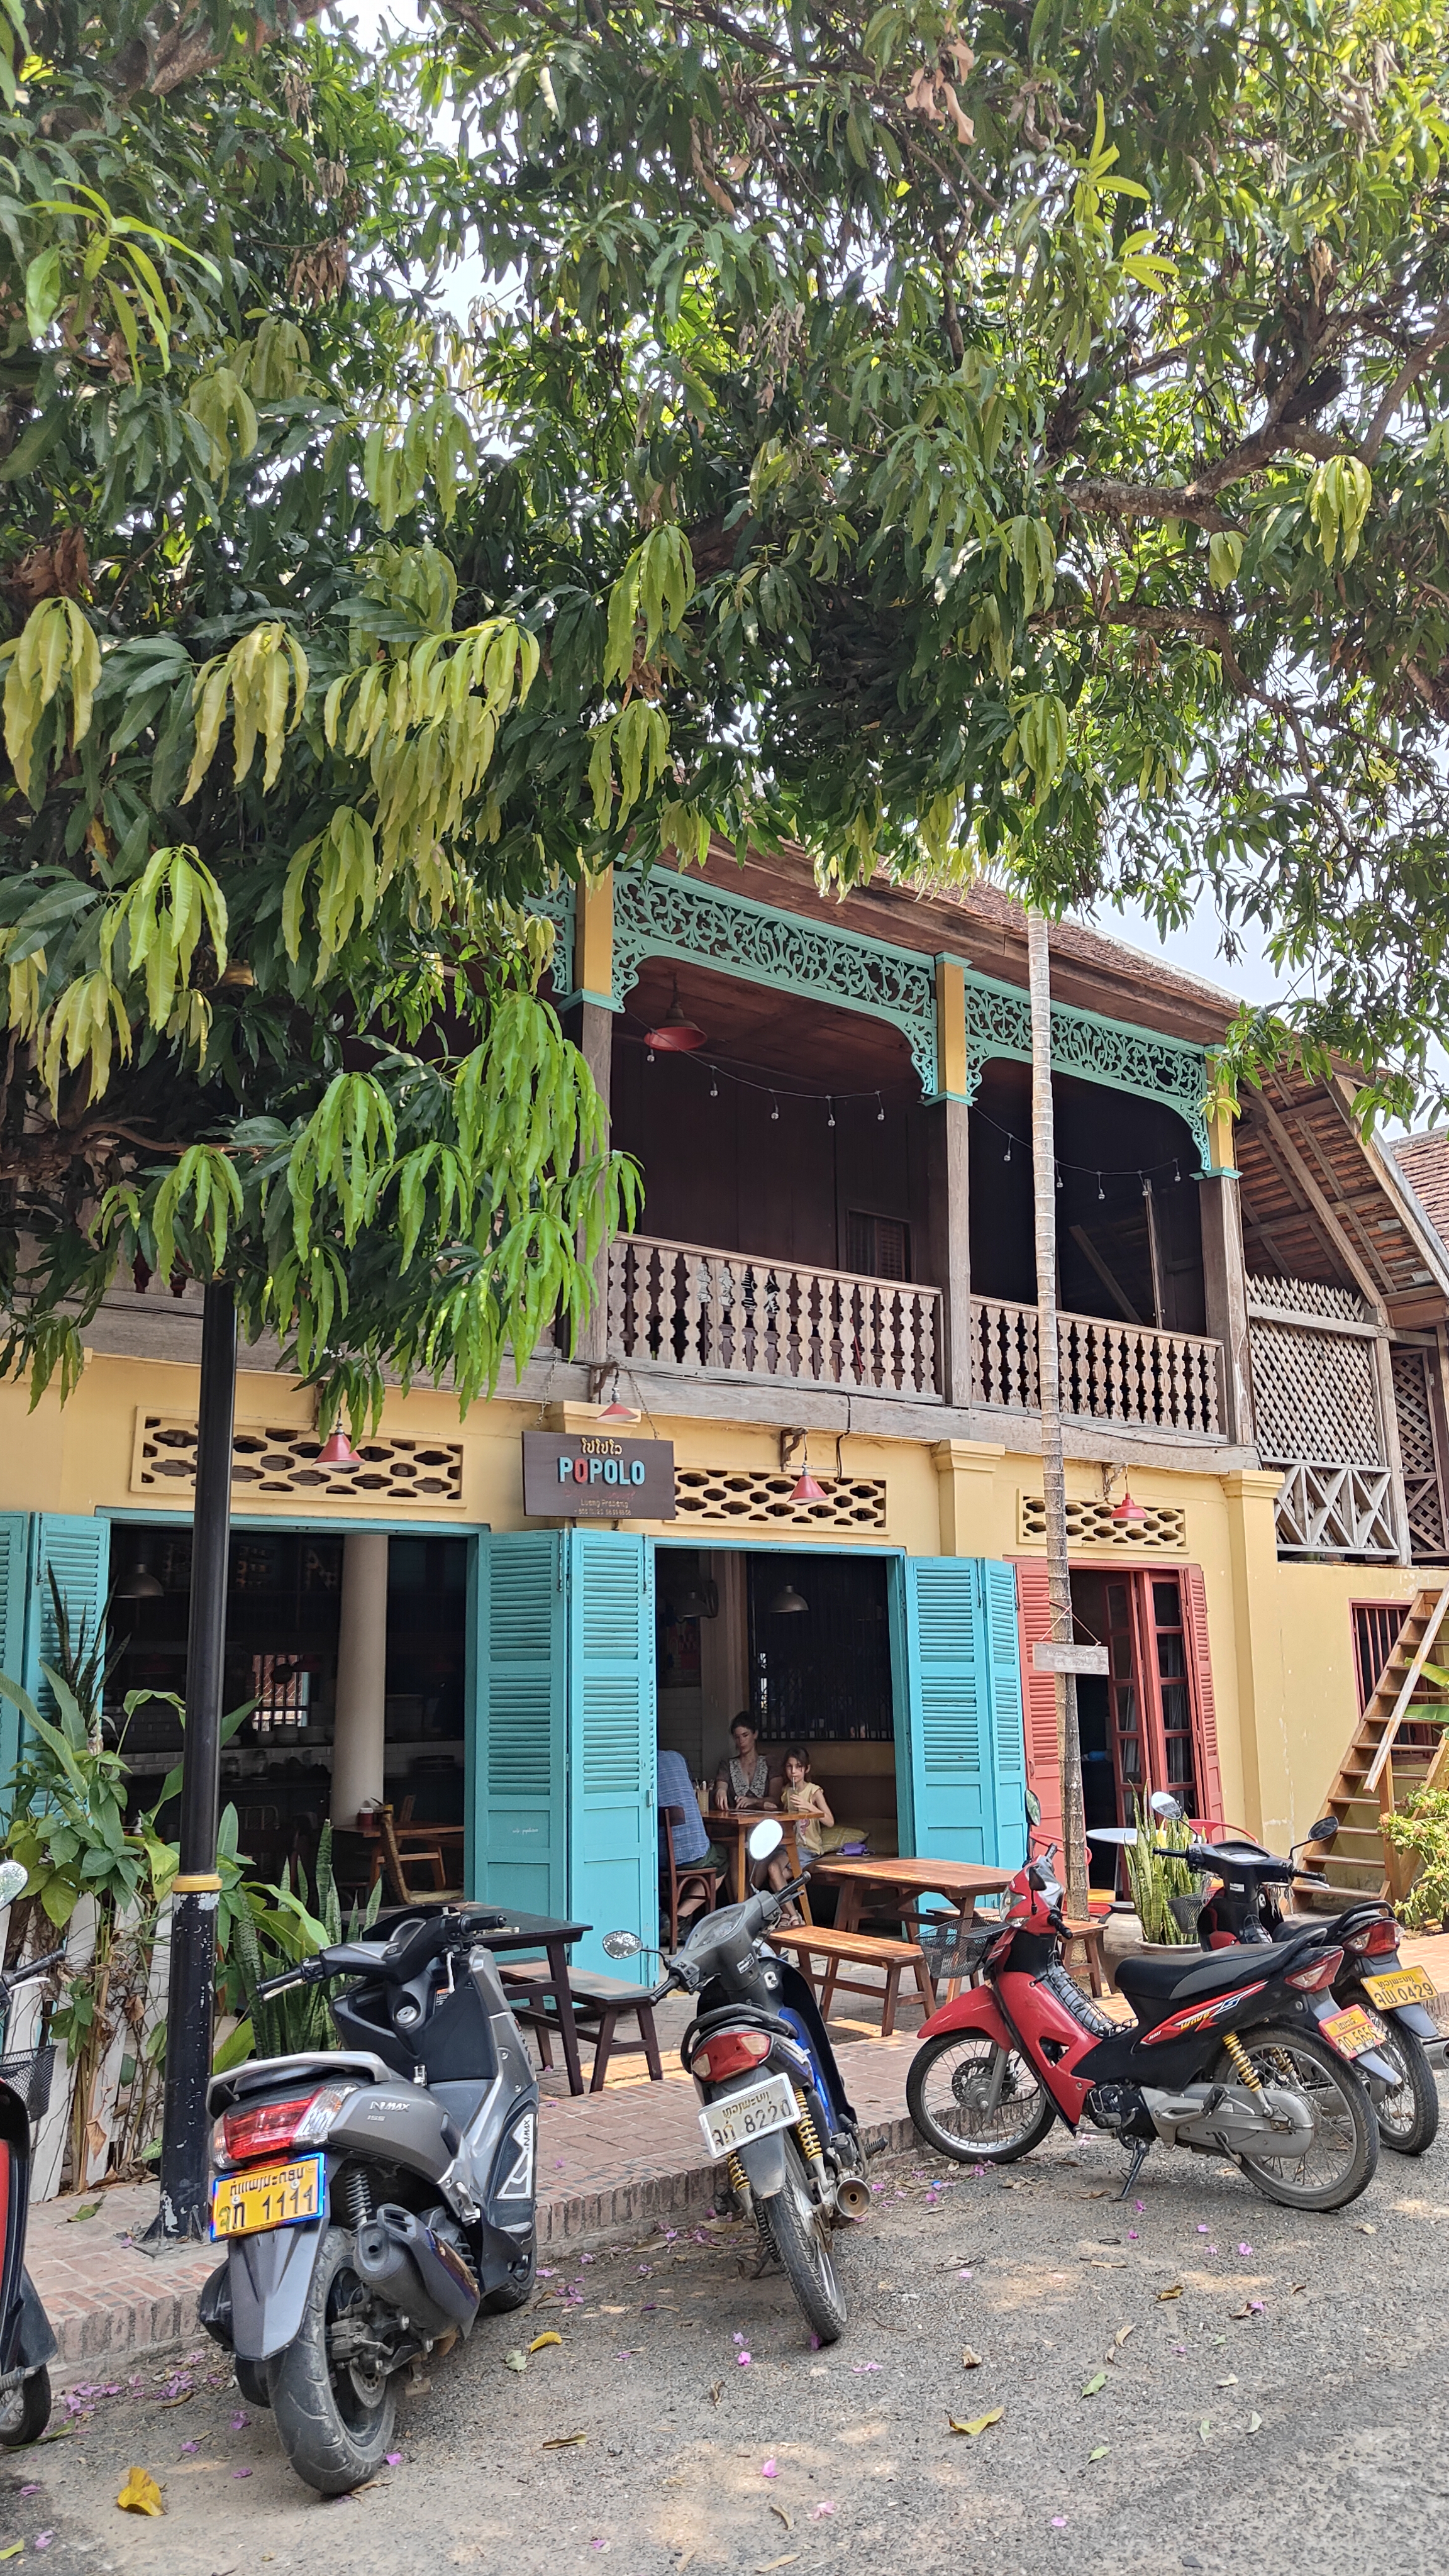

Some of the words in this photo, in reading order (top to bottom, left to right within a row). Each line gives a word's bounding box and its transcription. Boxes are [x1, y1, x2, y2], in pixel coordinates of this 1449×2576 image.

[558, 1457, 645, 1485] POPOLO
[1397, 1982, 1433, 2001] 0429
[369, 2101, 411, 2112] NMAX
[745, 2099, 792, 2133] 8220
[262, 2185, 313, 2221] 1111
